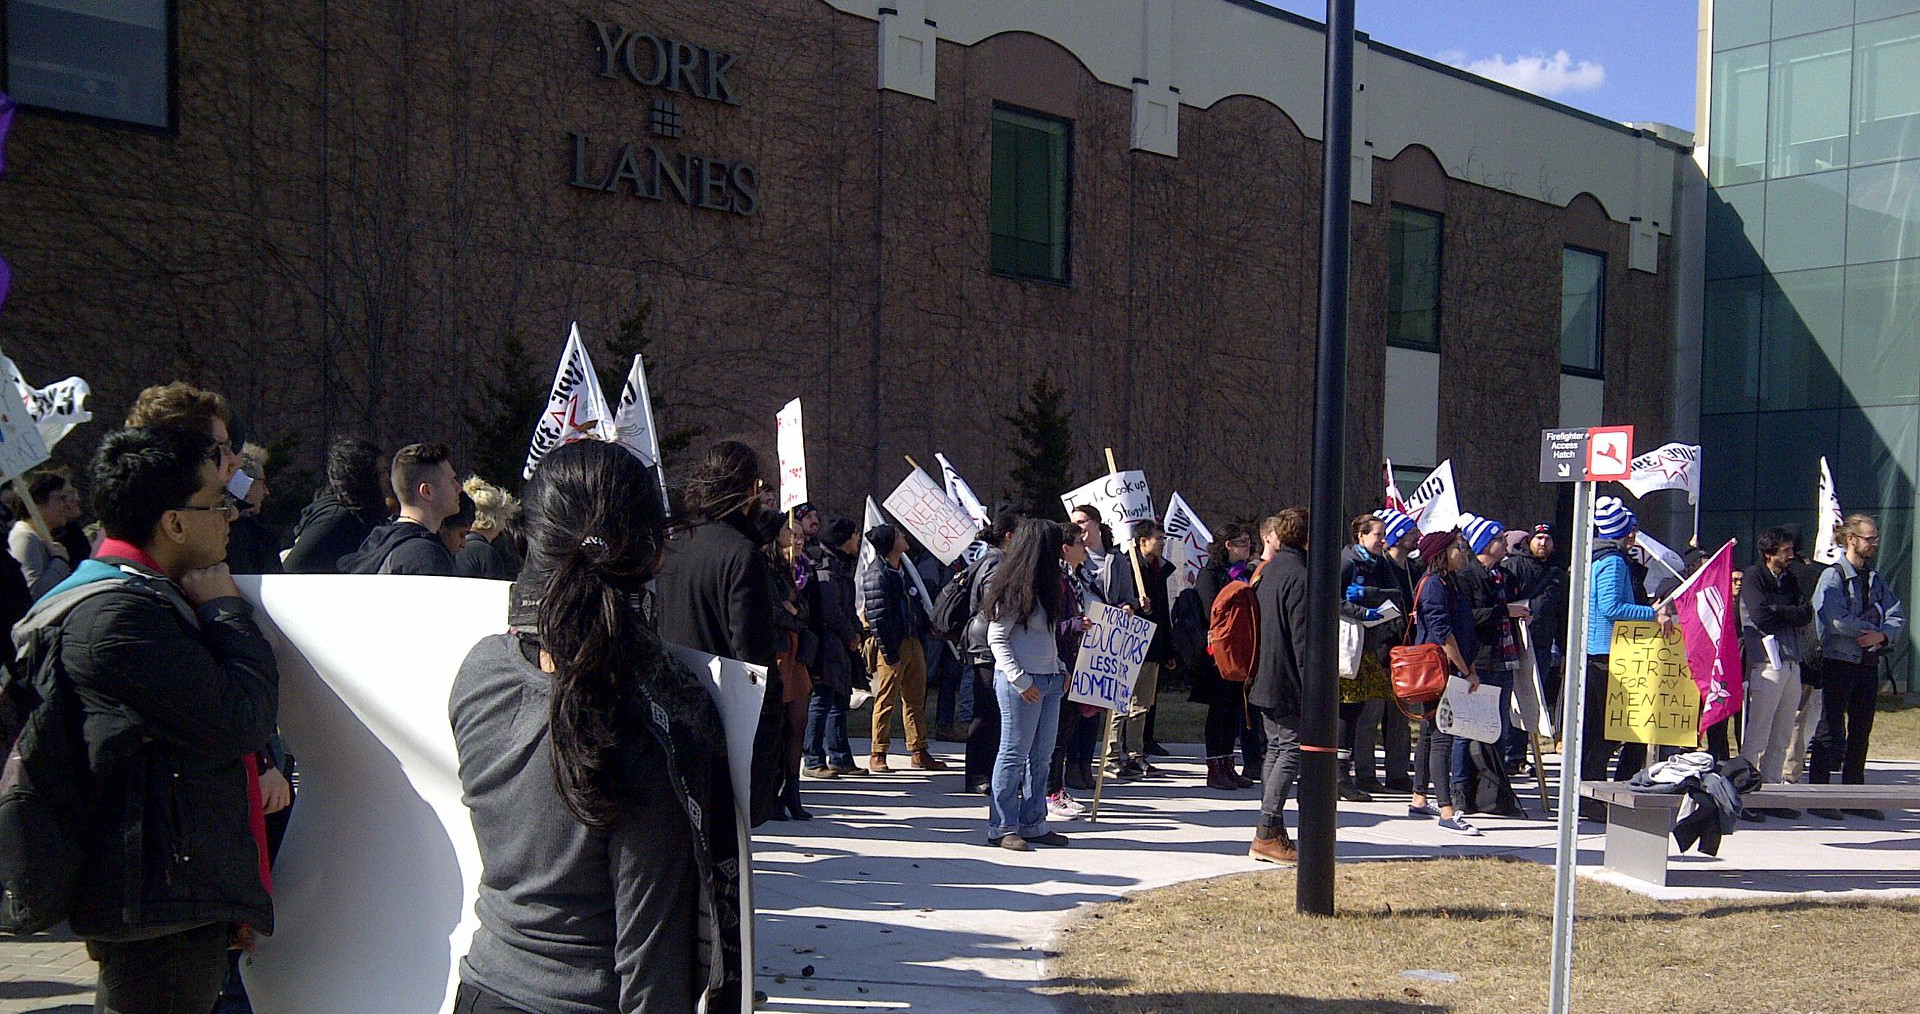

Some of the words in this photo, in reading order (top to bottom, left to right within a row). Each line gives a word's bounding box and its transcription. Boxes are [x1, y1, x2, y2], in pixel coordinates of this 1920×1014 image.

[588, 19, 742, 107] YORK
[569, 131, 759, 216] LANES
[1546, 432, 1584, 442] Firefighter
[1551, 442, 1579, 450] Access
[1553, 451, 1576, 459] Hatch
[1105, 479, 1134, 498] Cook
[1134, 480, 1146, 491] up
[904, 487, 947, 531] NEED
[1131, 617, 1150, 637] FOR
[1090, 655, 1118, 674] LESS
[1614, 658, 1692, 679] STRIK
[1620, 676, 1648, 688] FOR
[1658, 680, 1679, 690] MY
[1608, 691, 1693, 708] MENTAL
[1609, 710, 1691, 729] HEALTH
